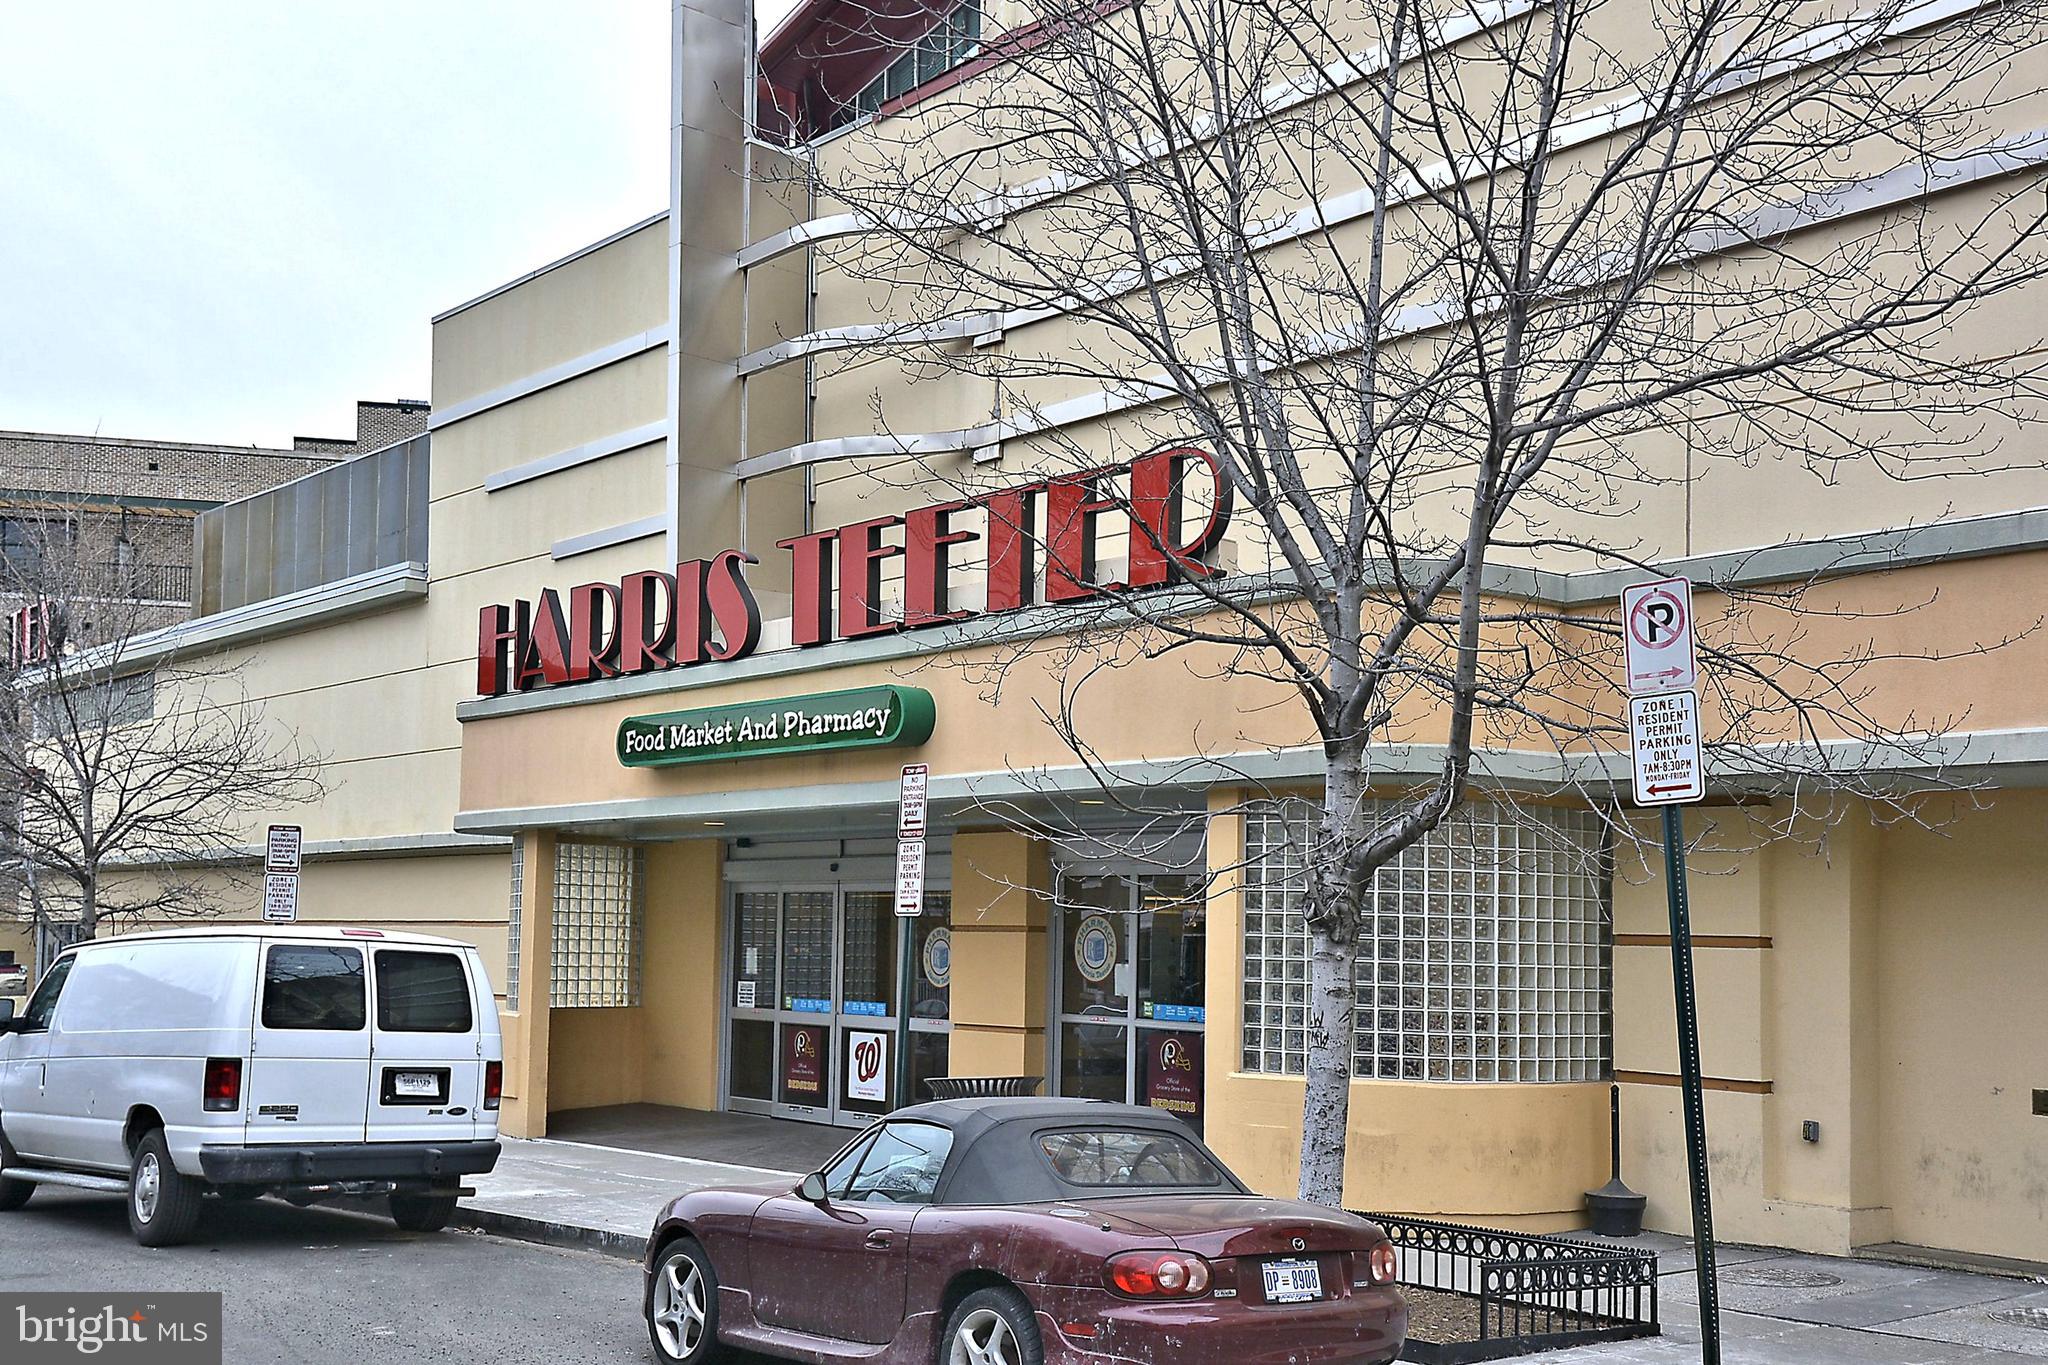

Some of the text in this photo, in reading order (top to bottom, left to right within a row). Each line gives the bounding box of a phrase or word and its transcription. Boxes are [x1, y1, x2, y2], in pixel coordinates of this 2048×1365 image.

[476, 447, 1234, 696] HARRIS TEETER
[1642, 698, 1684, 713] ZONE 1
[1638, 710, 1689, 725] RESIDENT
[625, 707, 892, 753] Food Market And Pharmacy
[1646, 723, 1682, 737] PERMIT
[1640, 734, 1692, 750] PARKING
[1654, 748, 1679, 762] ONLY
[1643, 759, 1692, 774] 7AM-8:30PM
[1645, 771, 1691, 782] MONDAY-FRIDAY
[904, 784, 924, 792] PARKING
[903, 793, 923, 801] ENTRANCE
[901, 854, 921, 862] RESIDENT
[1077, 919, 1115, 949] PHARMACY
[1151, 1097, 1196, 1113] REDSKINS
[1266, 1269, 1318, 1291] DP 8908
